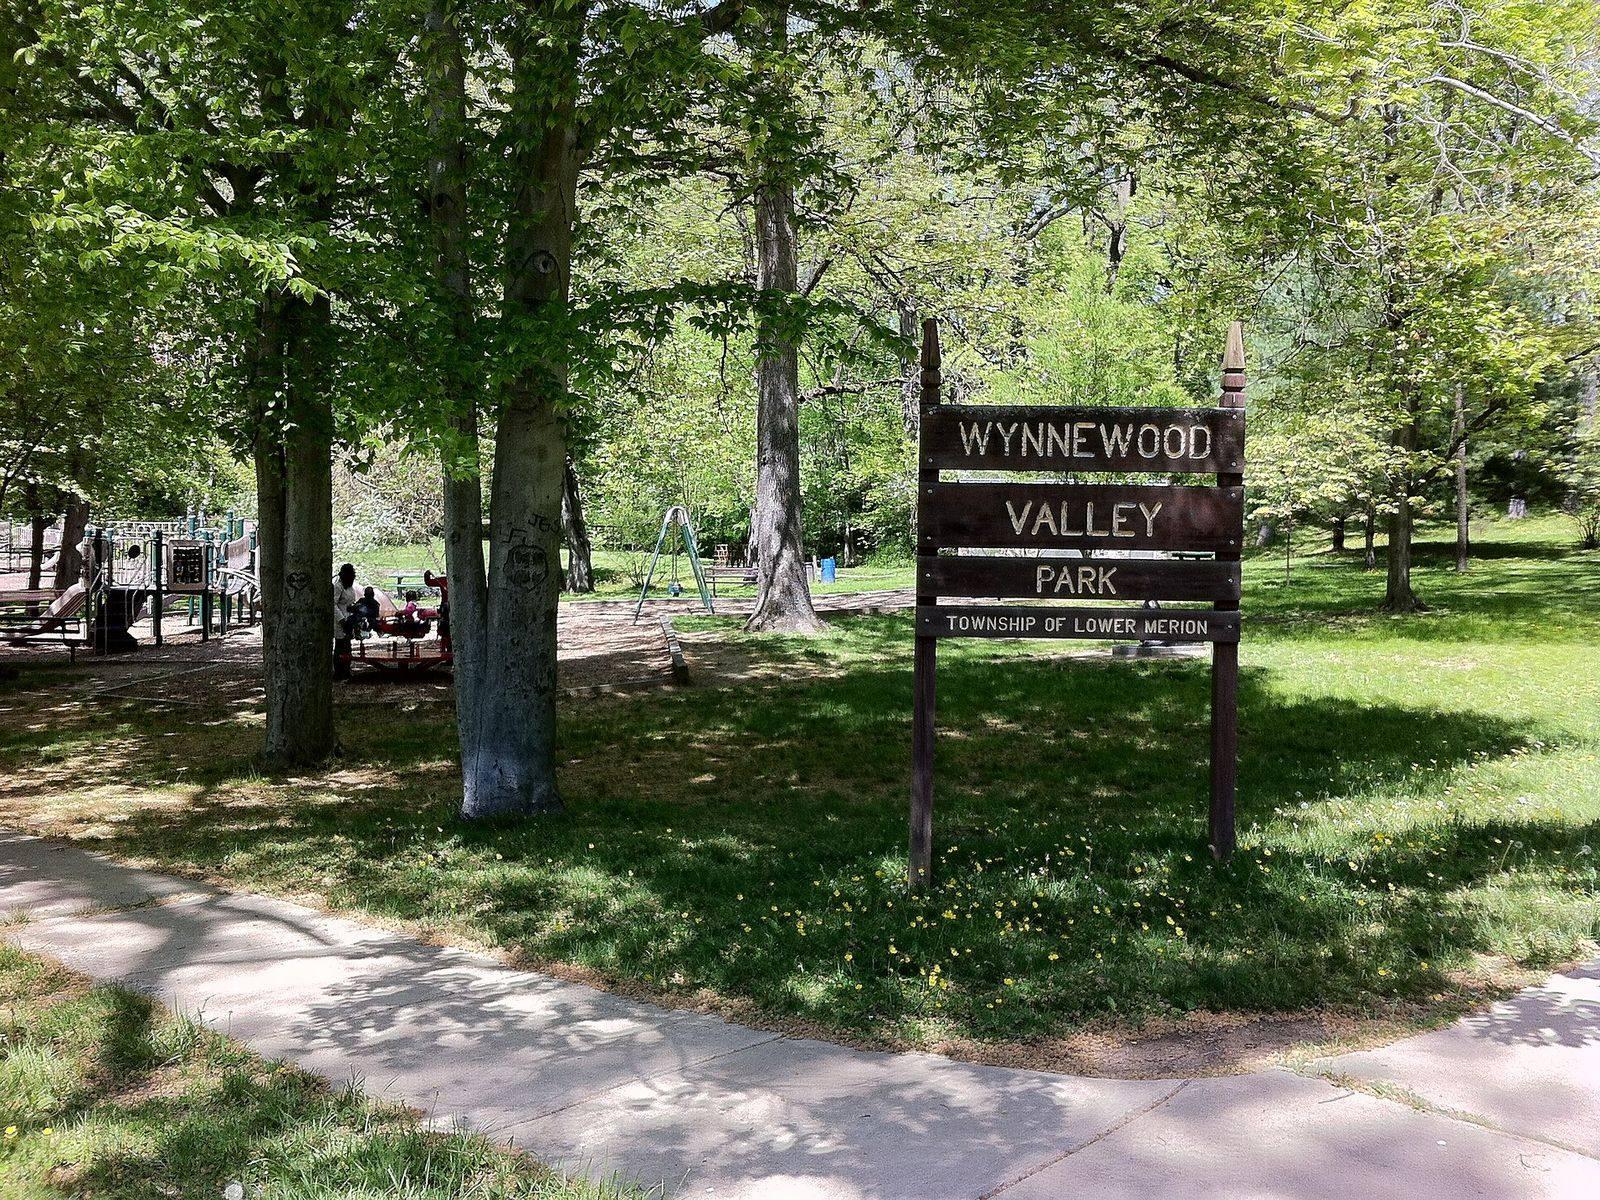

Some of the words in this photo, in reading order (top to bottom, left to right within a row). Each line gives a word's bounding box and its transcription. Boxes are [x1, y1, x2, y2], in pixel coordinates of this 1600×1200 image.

[958, 421, 1212, 460] WYNNEWOOD
[1005, 501, 1163, 537] VALLEY
[1036, 565, 1118, 595] PARK
[946, 615, 1037, 632] TOWNSHIP
[1045, 616, 1067, 632] OF
[1074, 617, 1137, 634] LOWER
[1144, 618, 1208, 635] MERION
